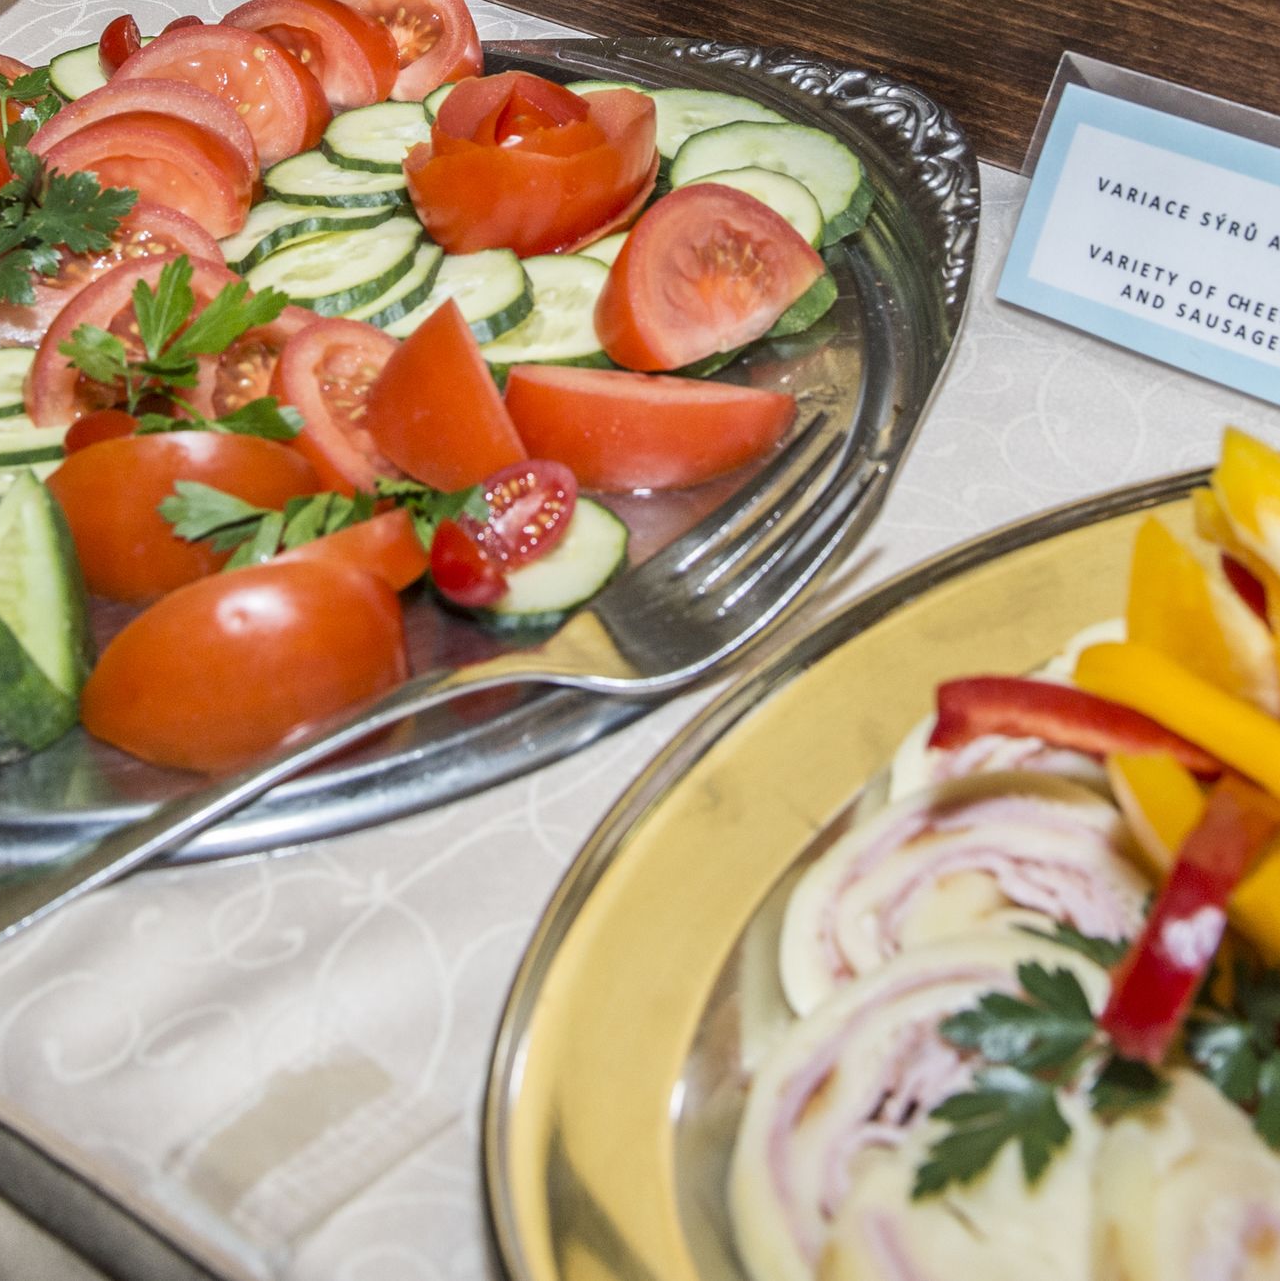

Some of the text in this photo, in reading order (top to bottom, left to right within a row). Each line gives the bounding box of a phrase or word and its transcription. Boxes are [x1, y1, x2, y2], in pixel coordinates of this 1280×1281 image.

[1097, 176, 1189, 220] VARIACE
[1200, 211, 1258, 242] SÝRŮ
[1088, 244, 1179, 288] VARIETY
[1189, 279, 1218, 301] OF
[1120, 283, 1165, 310] AND
